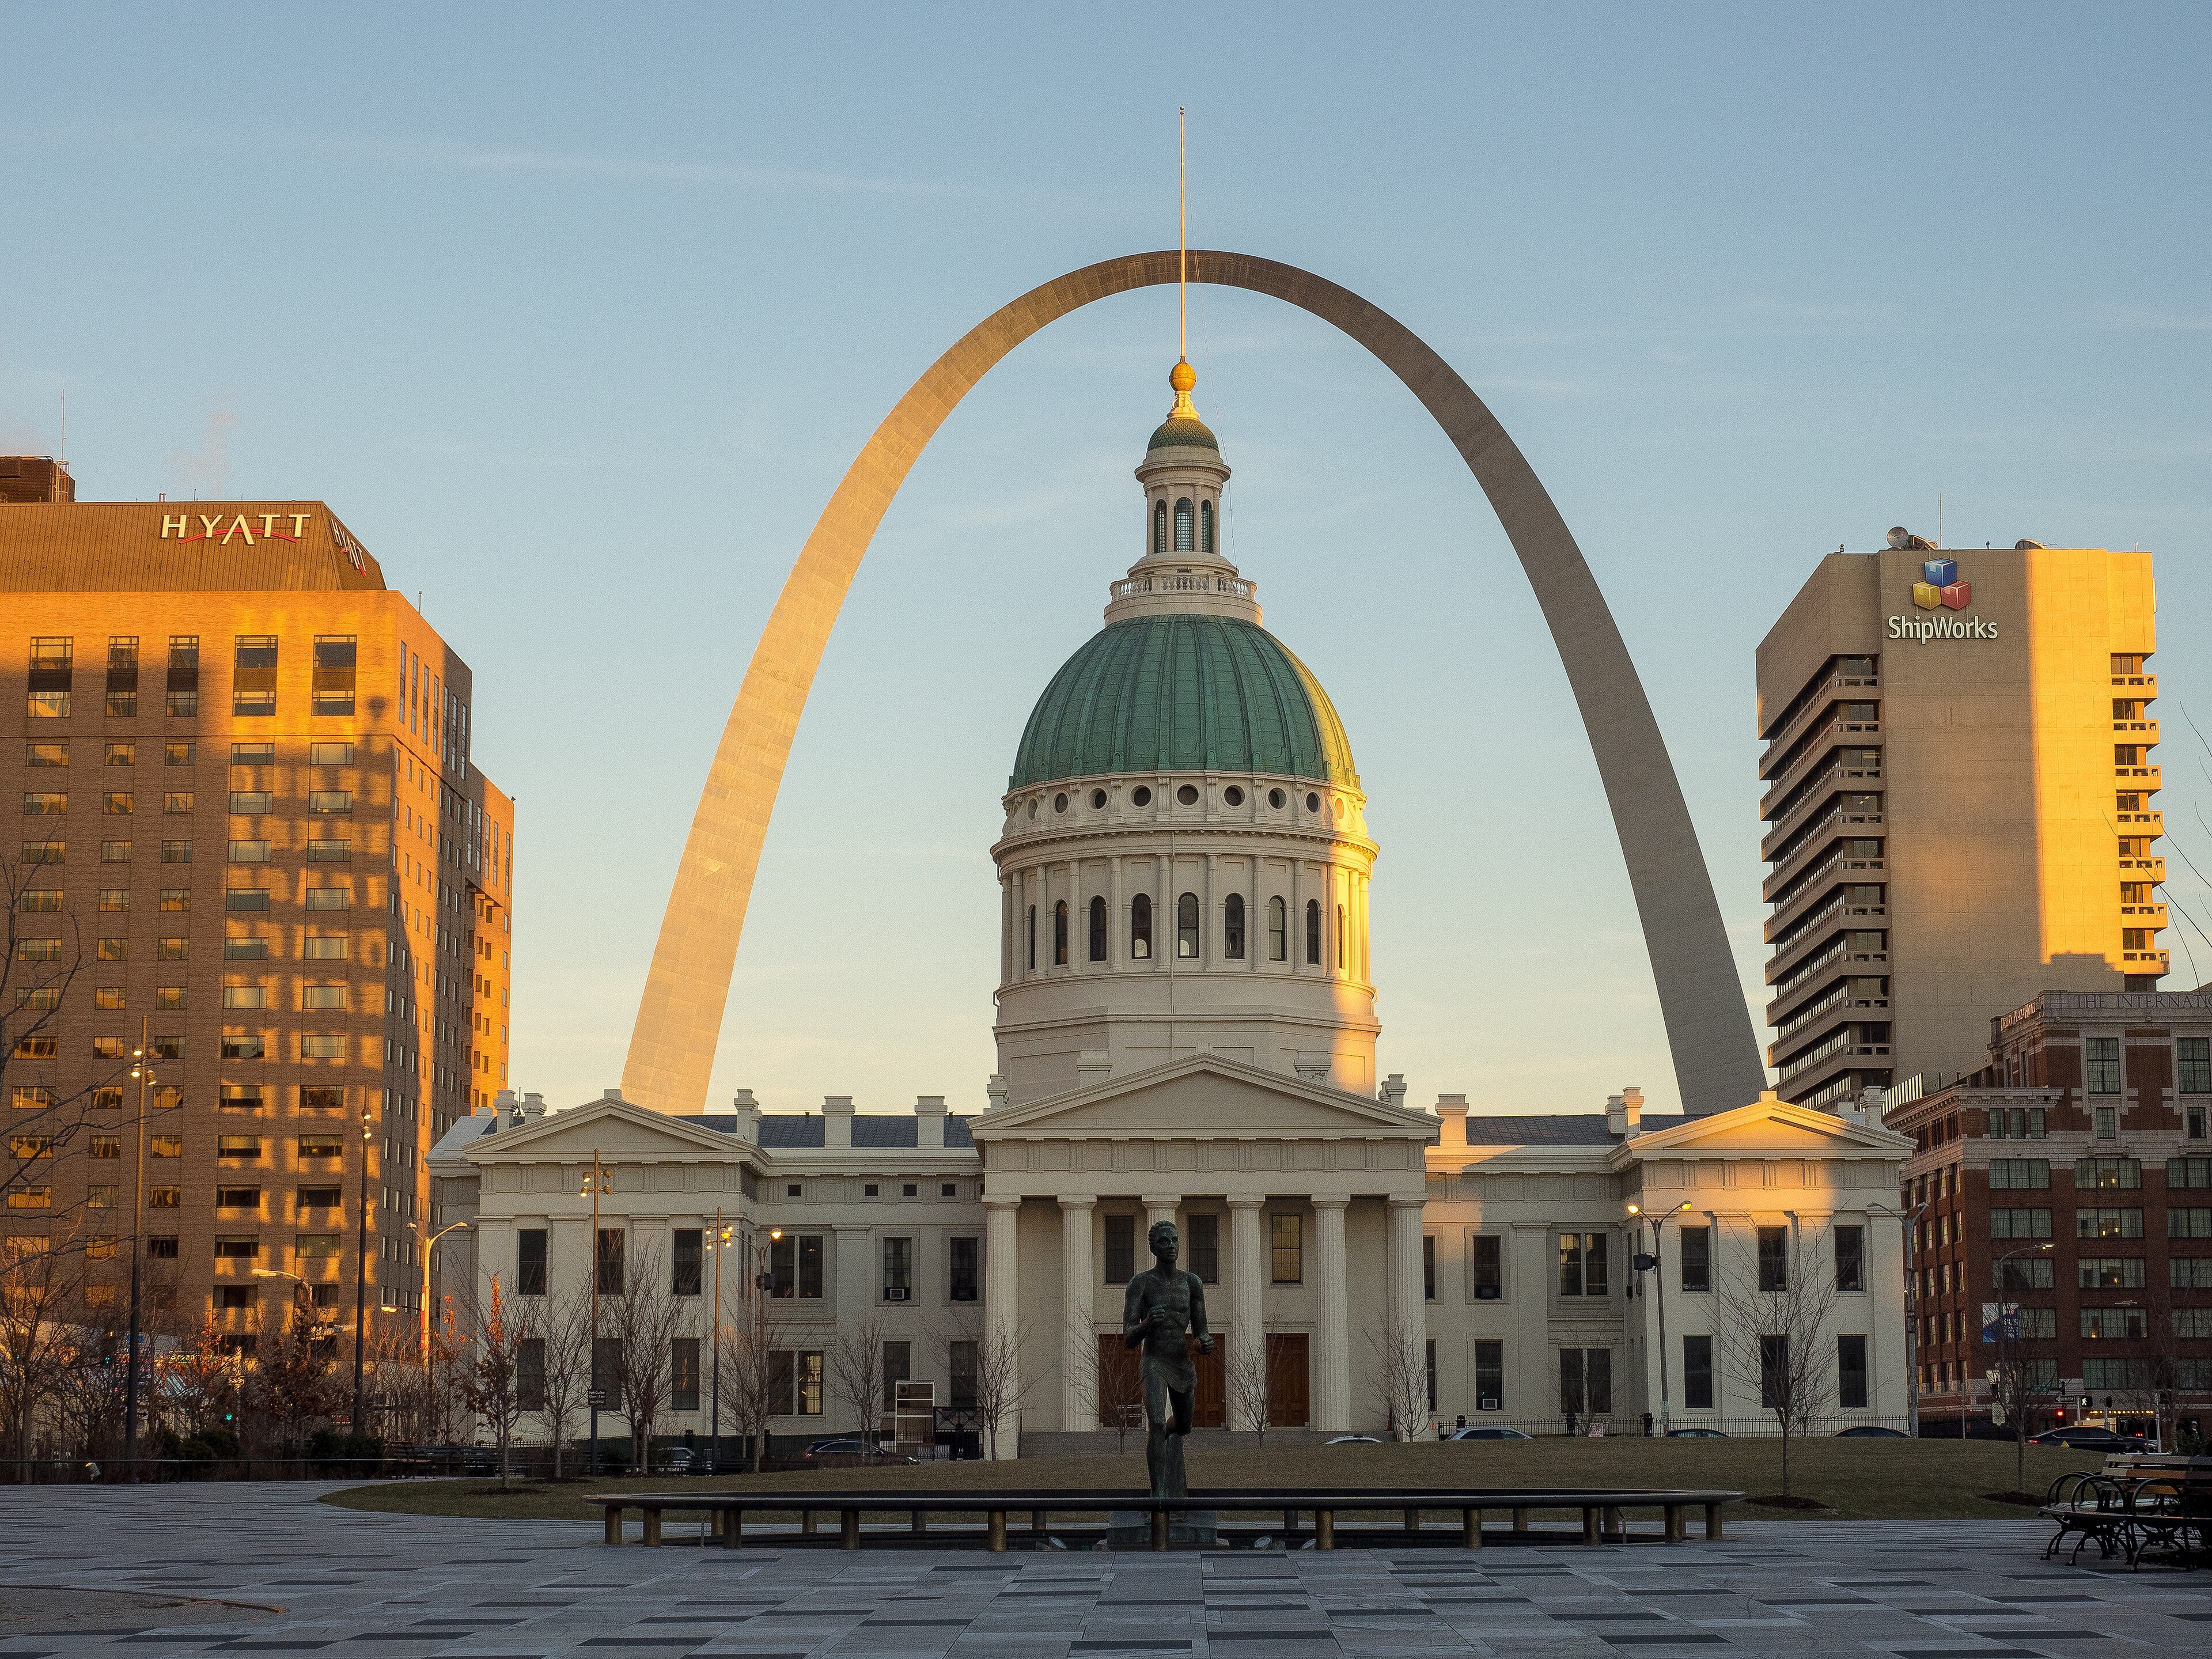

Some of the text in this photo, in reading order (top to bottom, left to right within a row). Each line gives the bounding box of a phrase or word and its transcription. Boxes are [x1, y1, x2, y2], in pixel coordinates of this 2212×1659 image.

[161, 514, 311, 545] HYATT
[328, 518, 366, 572] HYATT
[1888, 615, 1998, 645] ShipWorks
[2074, 995, 2108, 1008] THE
